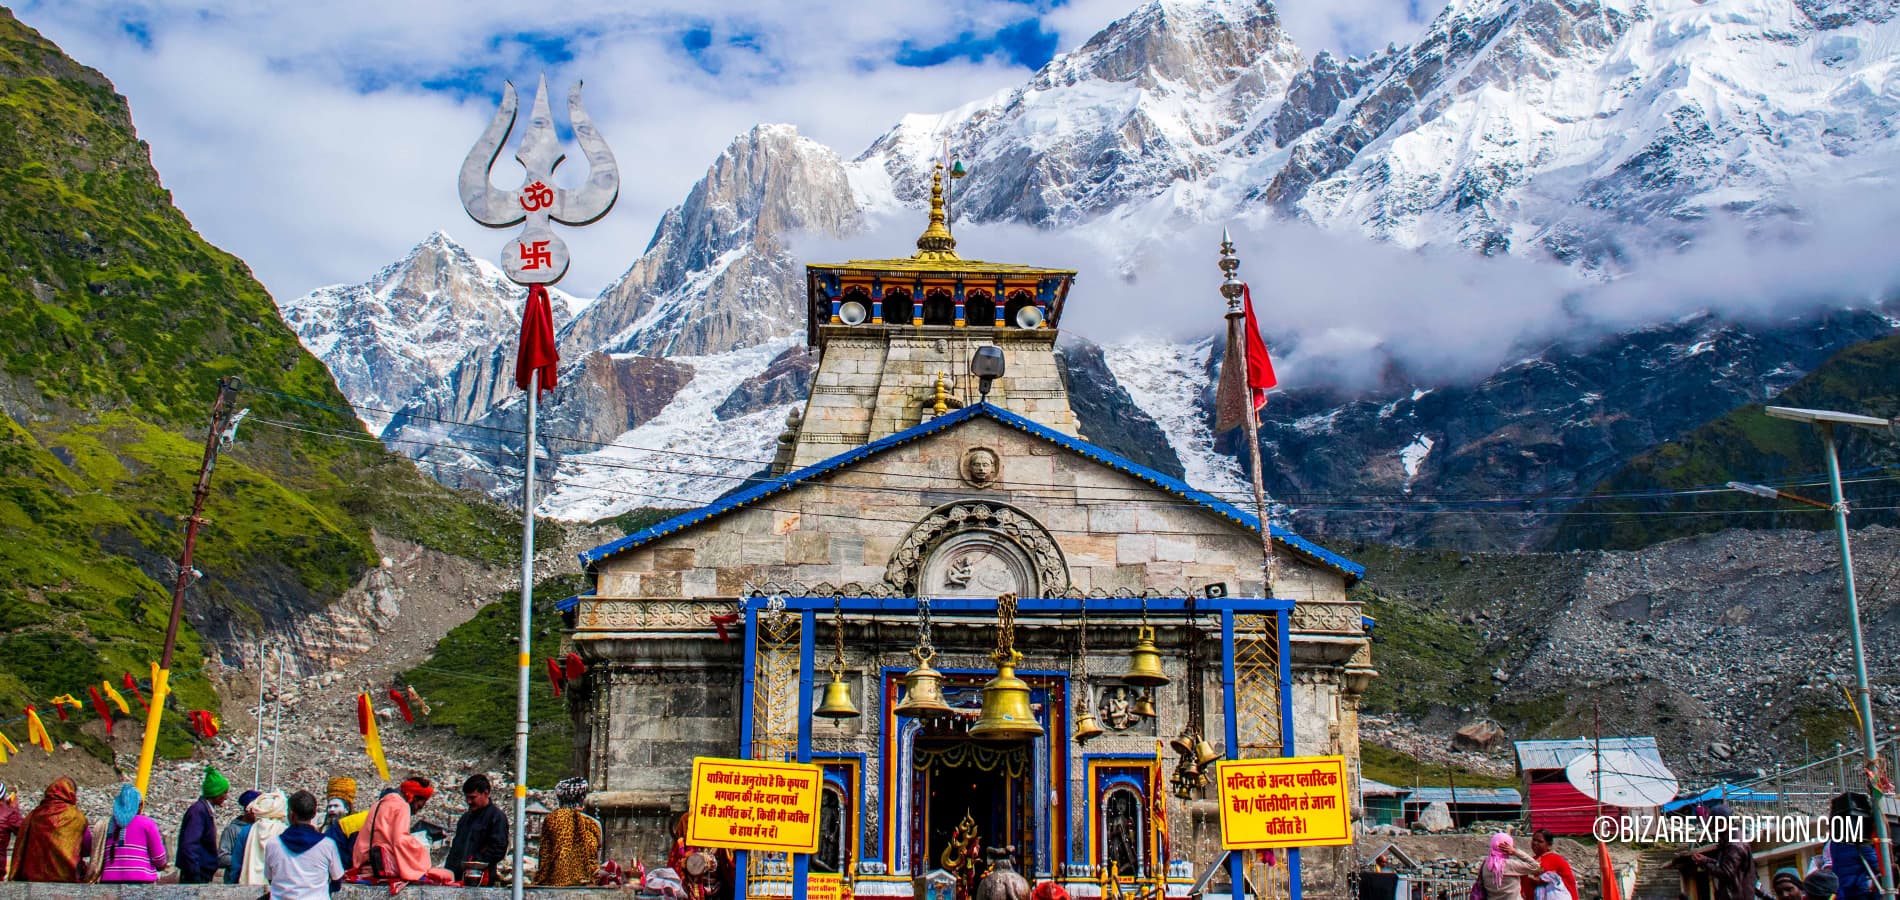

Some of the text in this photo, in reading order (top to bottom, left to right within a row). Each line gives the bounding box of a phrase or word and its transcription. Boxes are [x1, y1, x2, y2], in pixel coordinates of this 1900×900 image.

[707, 771, 809, 792] यात्रियों से अनुरोध है कि कृपया
[1227, 769, 1337, 790] मन्दिर के अन्दर प्लास्टिक
[715, 789, 799, 805] भगवान की भेंट दान पात्रों
[1300, 793, 1309, 810] ले
[1311, 796, 1335, 809] जाना
[708, 804, 716, 817] ही
[718, 805, 739, 819] अर्पित
[757, 808, 776, 821] किसी
[778, 809, 786, 822] भी
[787, 810, 810, 823] व्यक्ति
[730, 823, 737, 835] के
[761, 828, 768, 837] न
[1266, 816, 1294, 835] वर्जित
